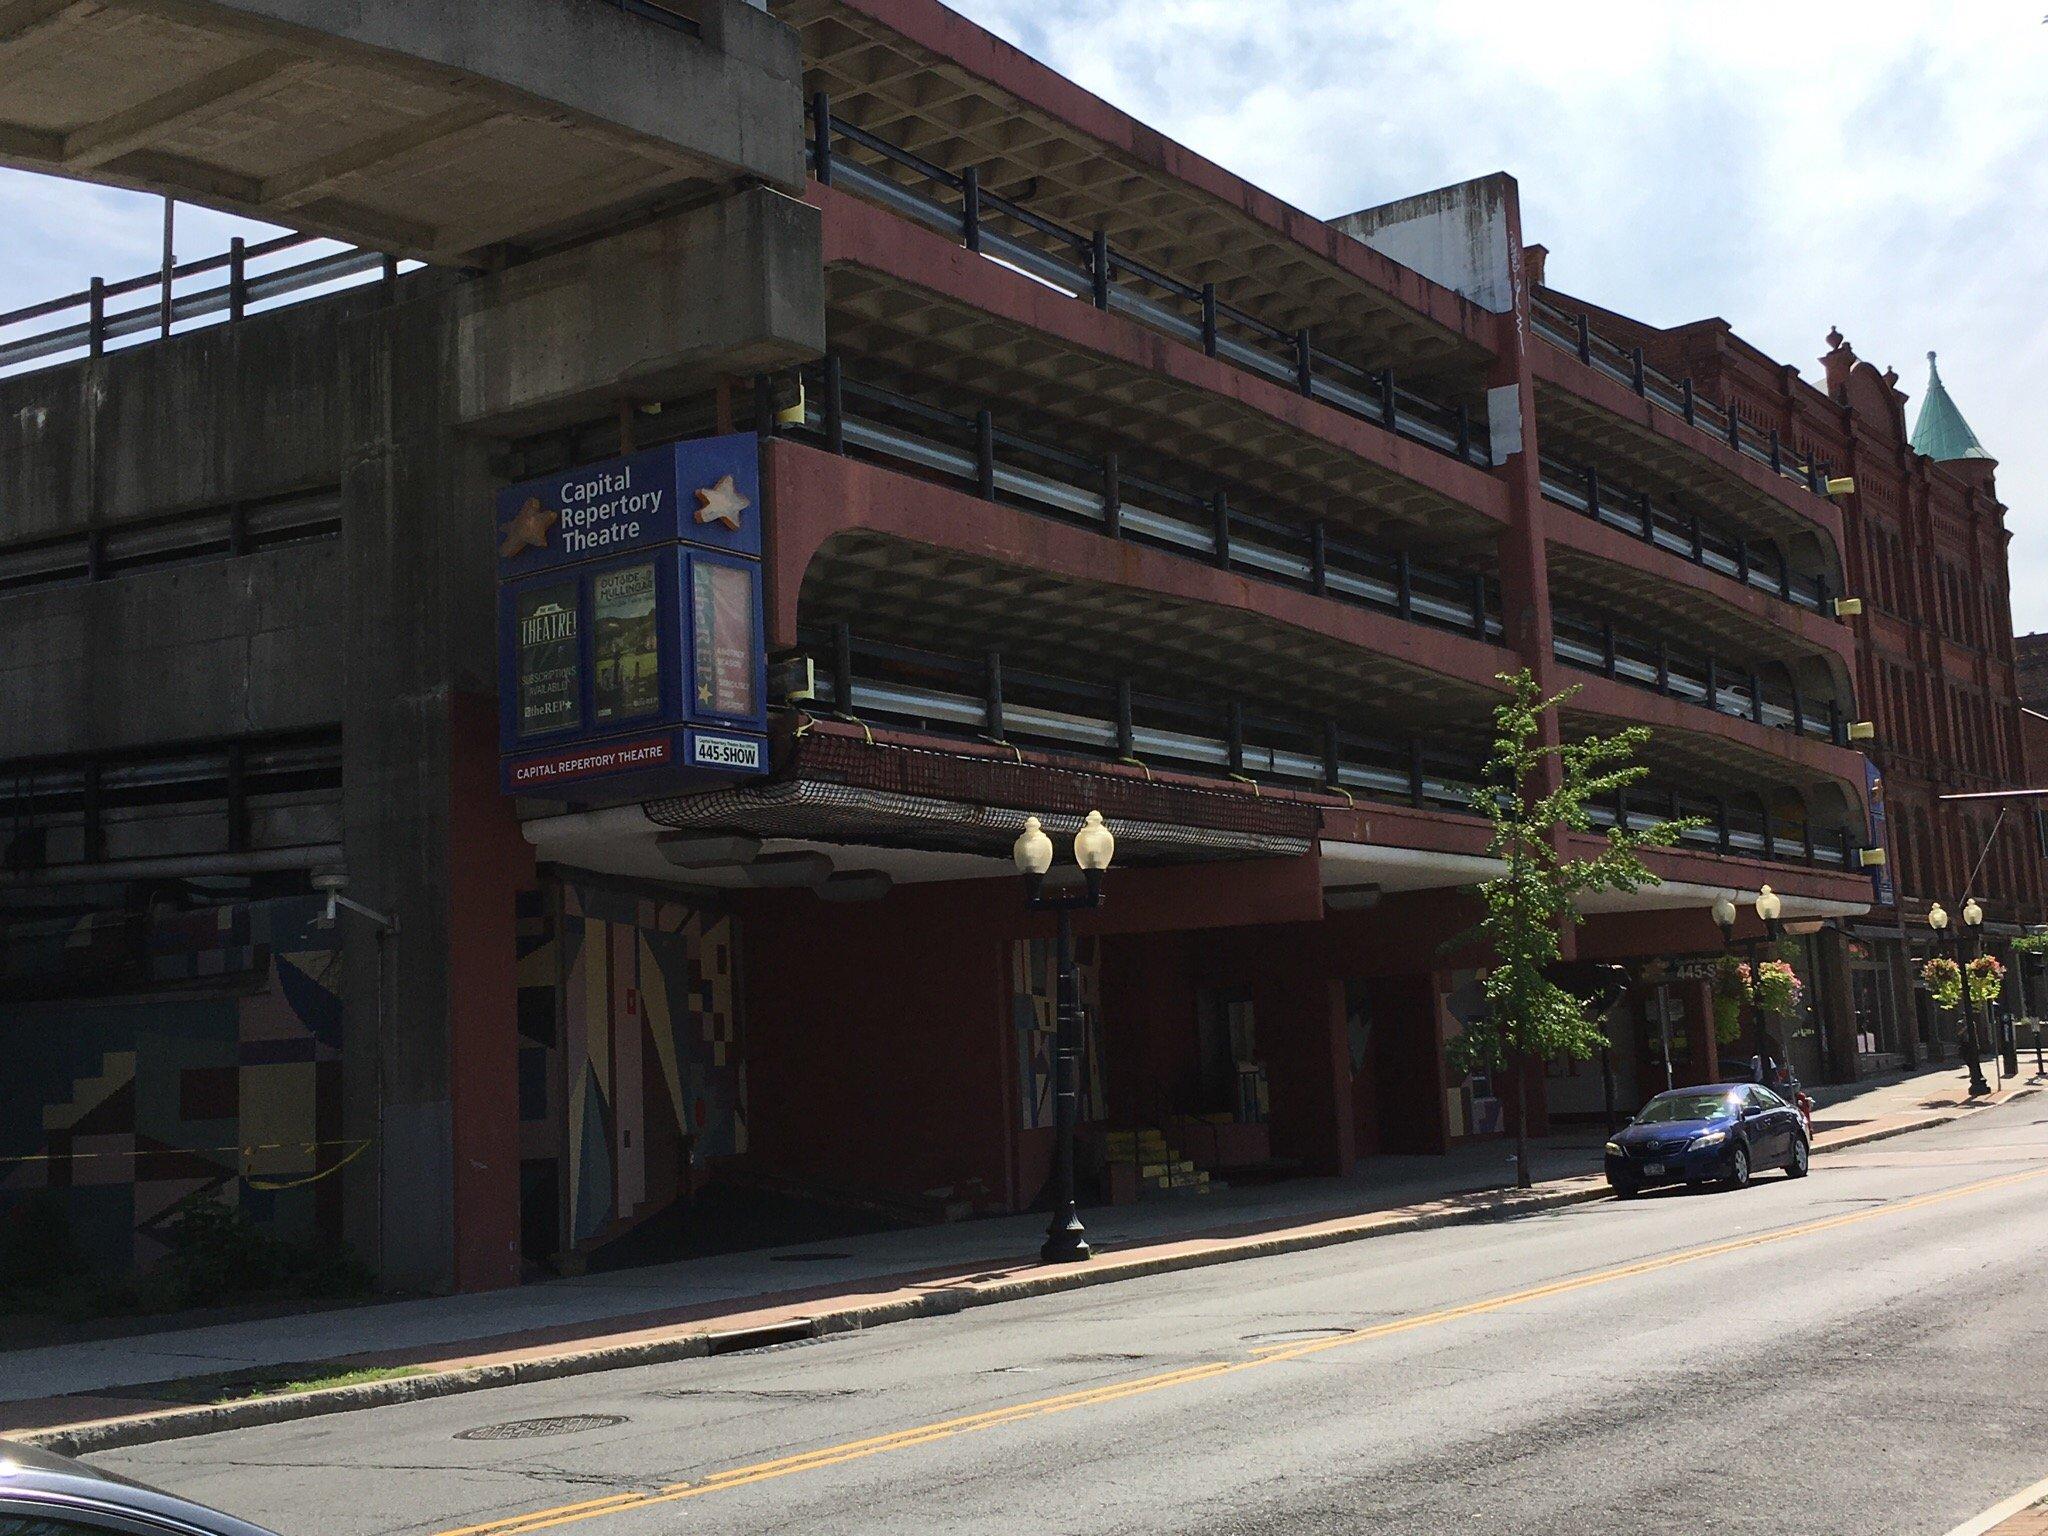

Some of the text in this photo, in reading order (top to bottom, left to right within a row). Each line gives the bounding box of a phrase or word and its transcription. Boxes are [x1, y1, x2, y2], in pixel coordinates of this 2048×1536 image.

[561, 465, 631, 504] Capital
[561, 490, 663, 529] Repertory
[562, 521, 640, 553] Theatre
[517, 745, 663, 779] CAPITAL REPERTORY THEATRE
[699, 744, 756, 764] 445-SHOW
